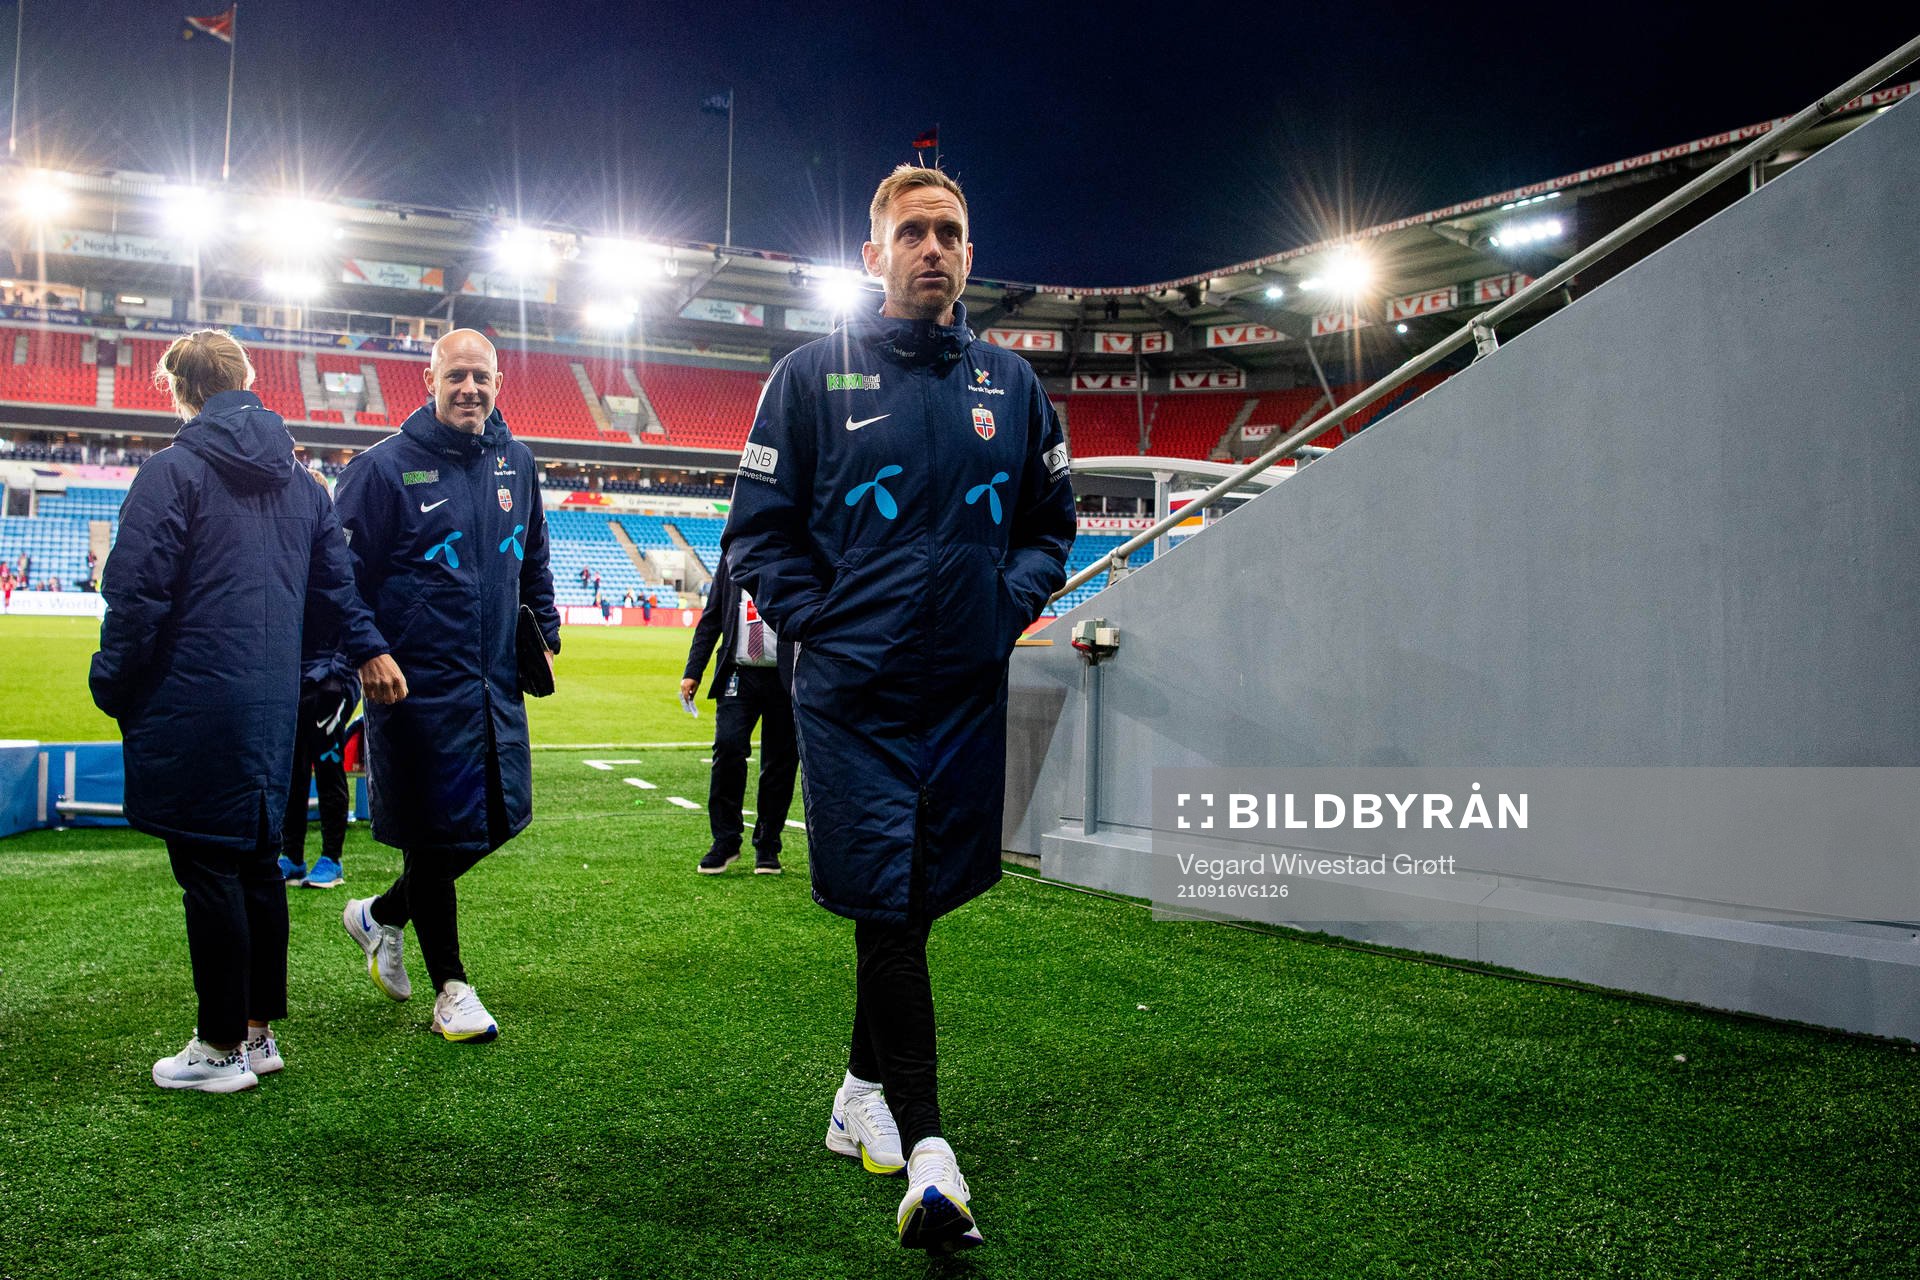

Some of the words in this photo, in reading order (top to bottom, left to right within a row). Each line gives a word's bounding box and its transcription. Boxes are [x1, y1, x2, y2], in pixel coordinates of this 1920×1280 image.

[1873, 84, 1910, 104] VG
[1739, 122, 1771, 138] VG
[1699, 133, 1728, 149] VG
[1661, 143, 1689, 160] VG
[84, 239, 120, 252] Norsk
[124, 242, 169, 260] Tipping
[1395, 291, 1449, 316] VG
[989, 331, 1055, 349] VG
[1107, 335, 1163, 351] VG
[1215, 326, 1274, 344] VG
[827, 374, 864, 391] KIWI
[1079, 374, 1140, 389] VG
[1178, 372, 1237, 388] VG
[1089, 520, 1119, 529] VG
